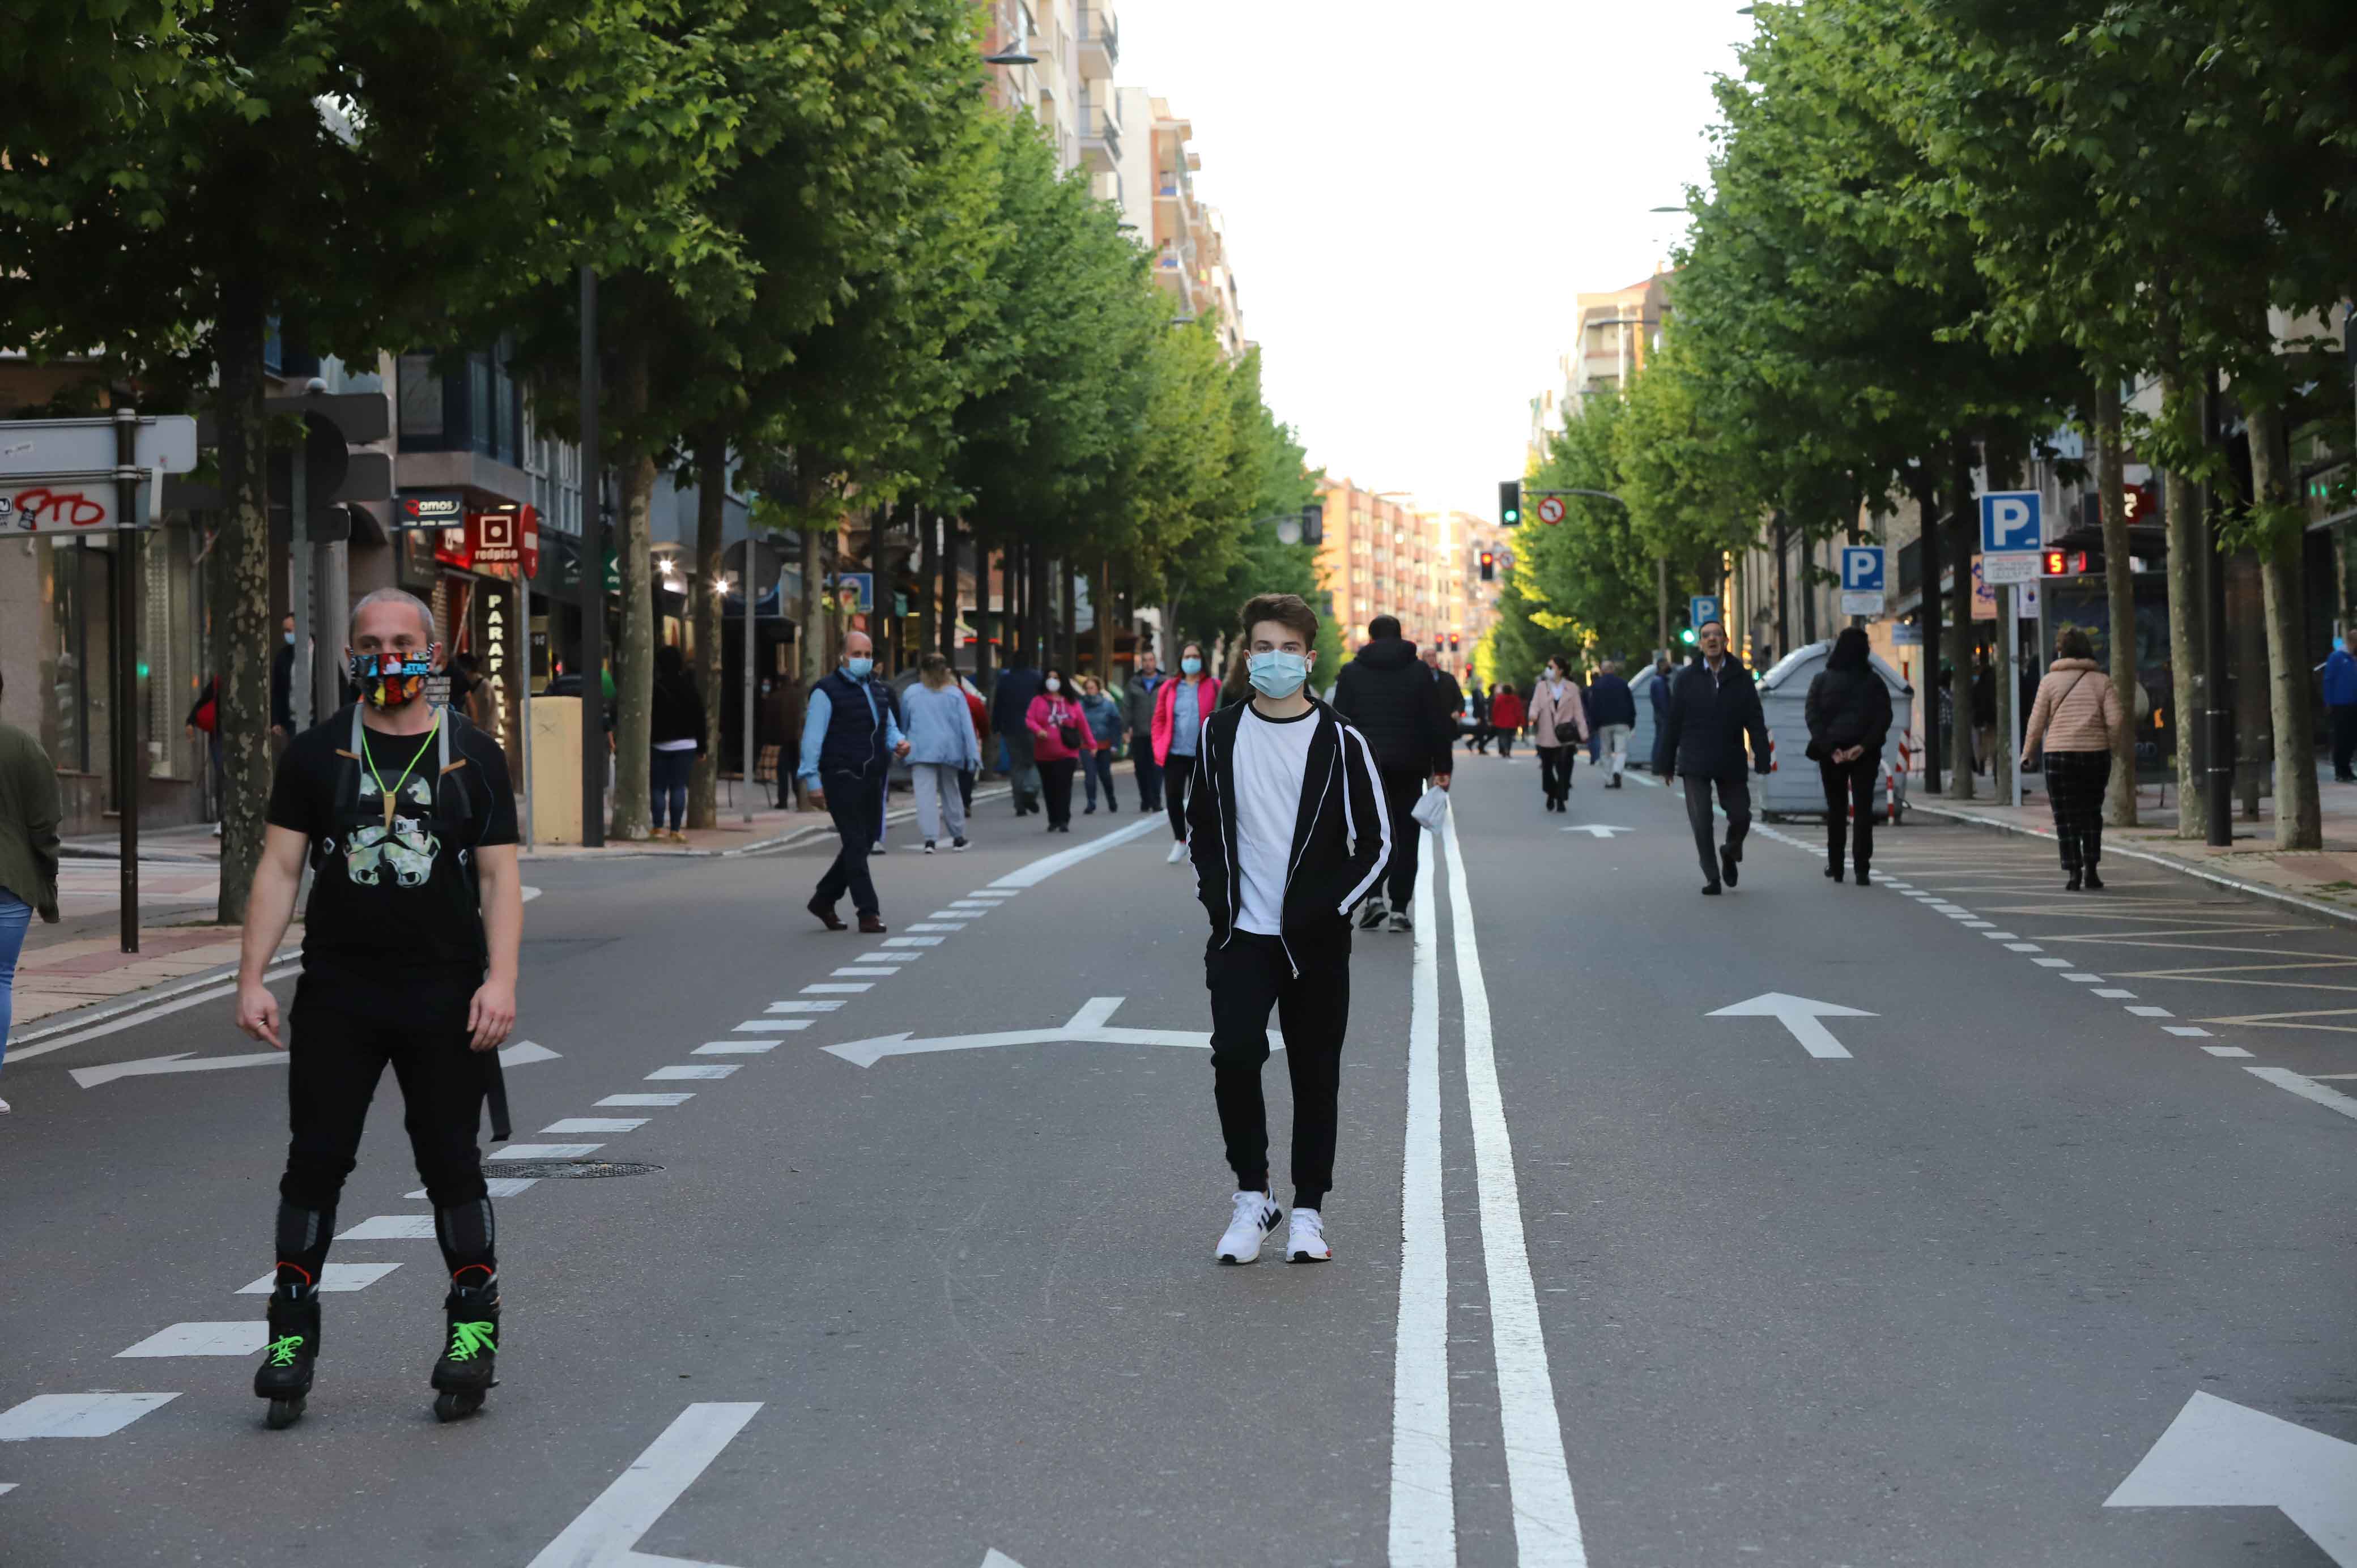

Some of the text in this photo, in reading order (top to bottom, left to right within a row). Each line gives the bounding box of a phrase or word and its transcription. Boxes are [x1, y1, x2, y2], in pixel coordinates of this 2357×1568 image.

[1993, 500, 2030, 546] P
[1850, 551, 1877, 586] P
[1697, 600, 1714, 623] P
